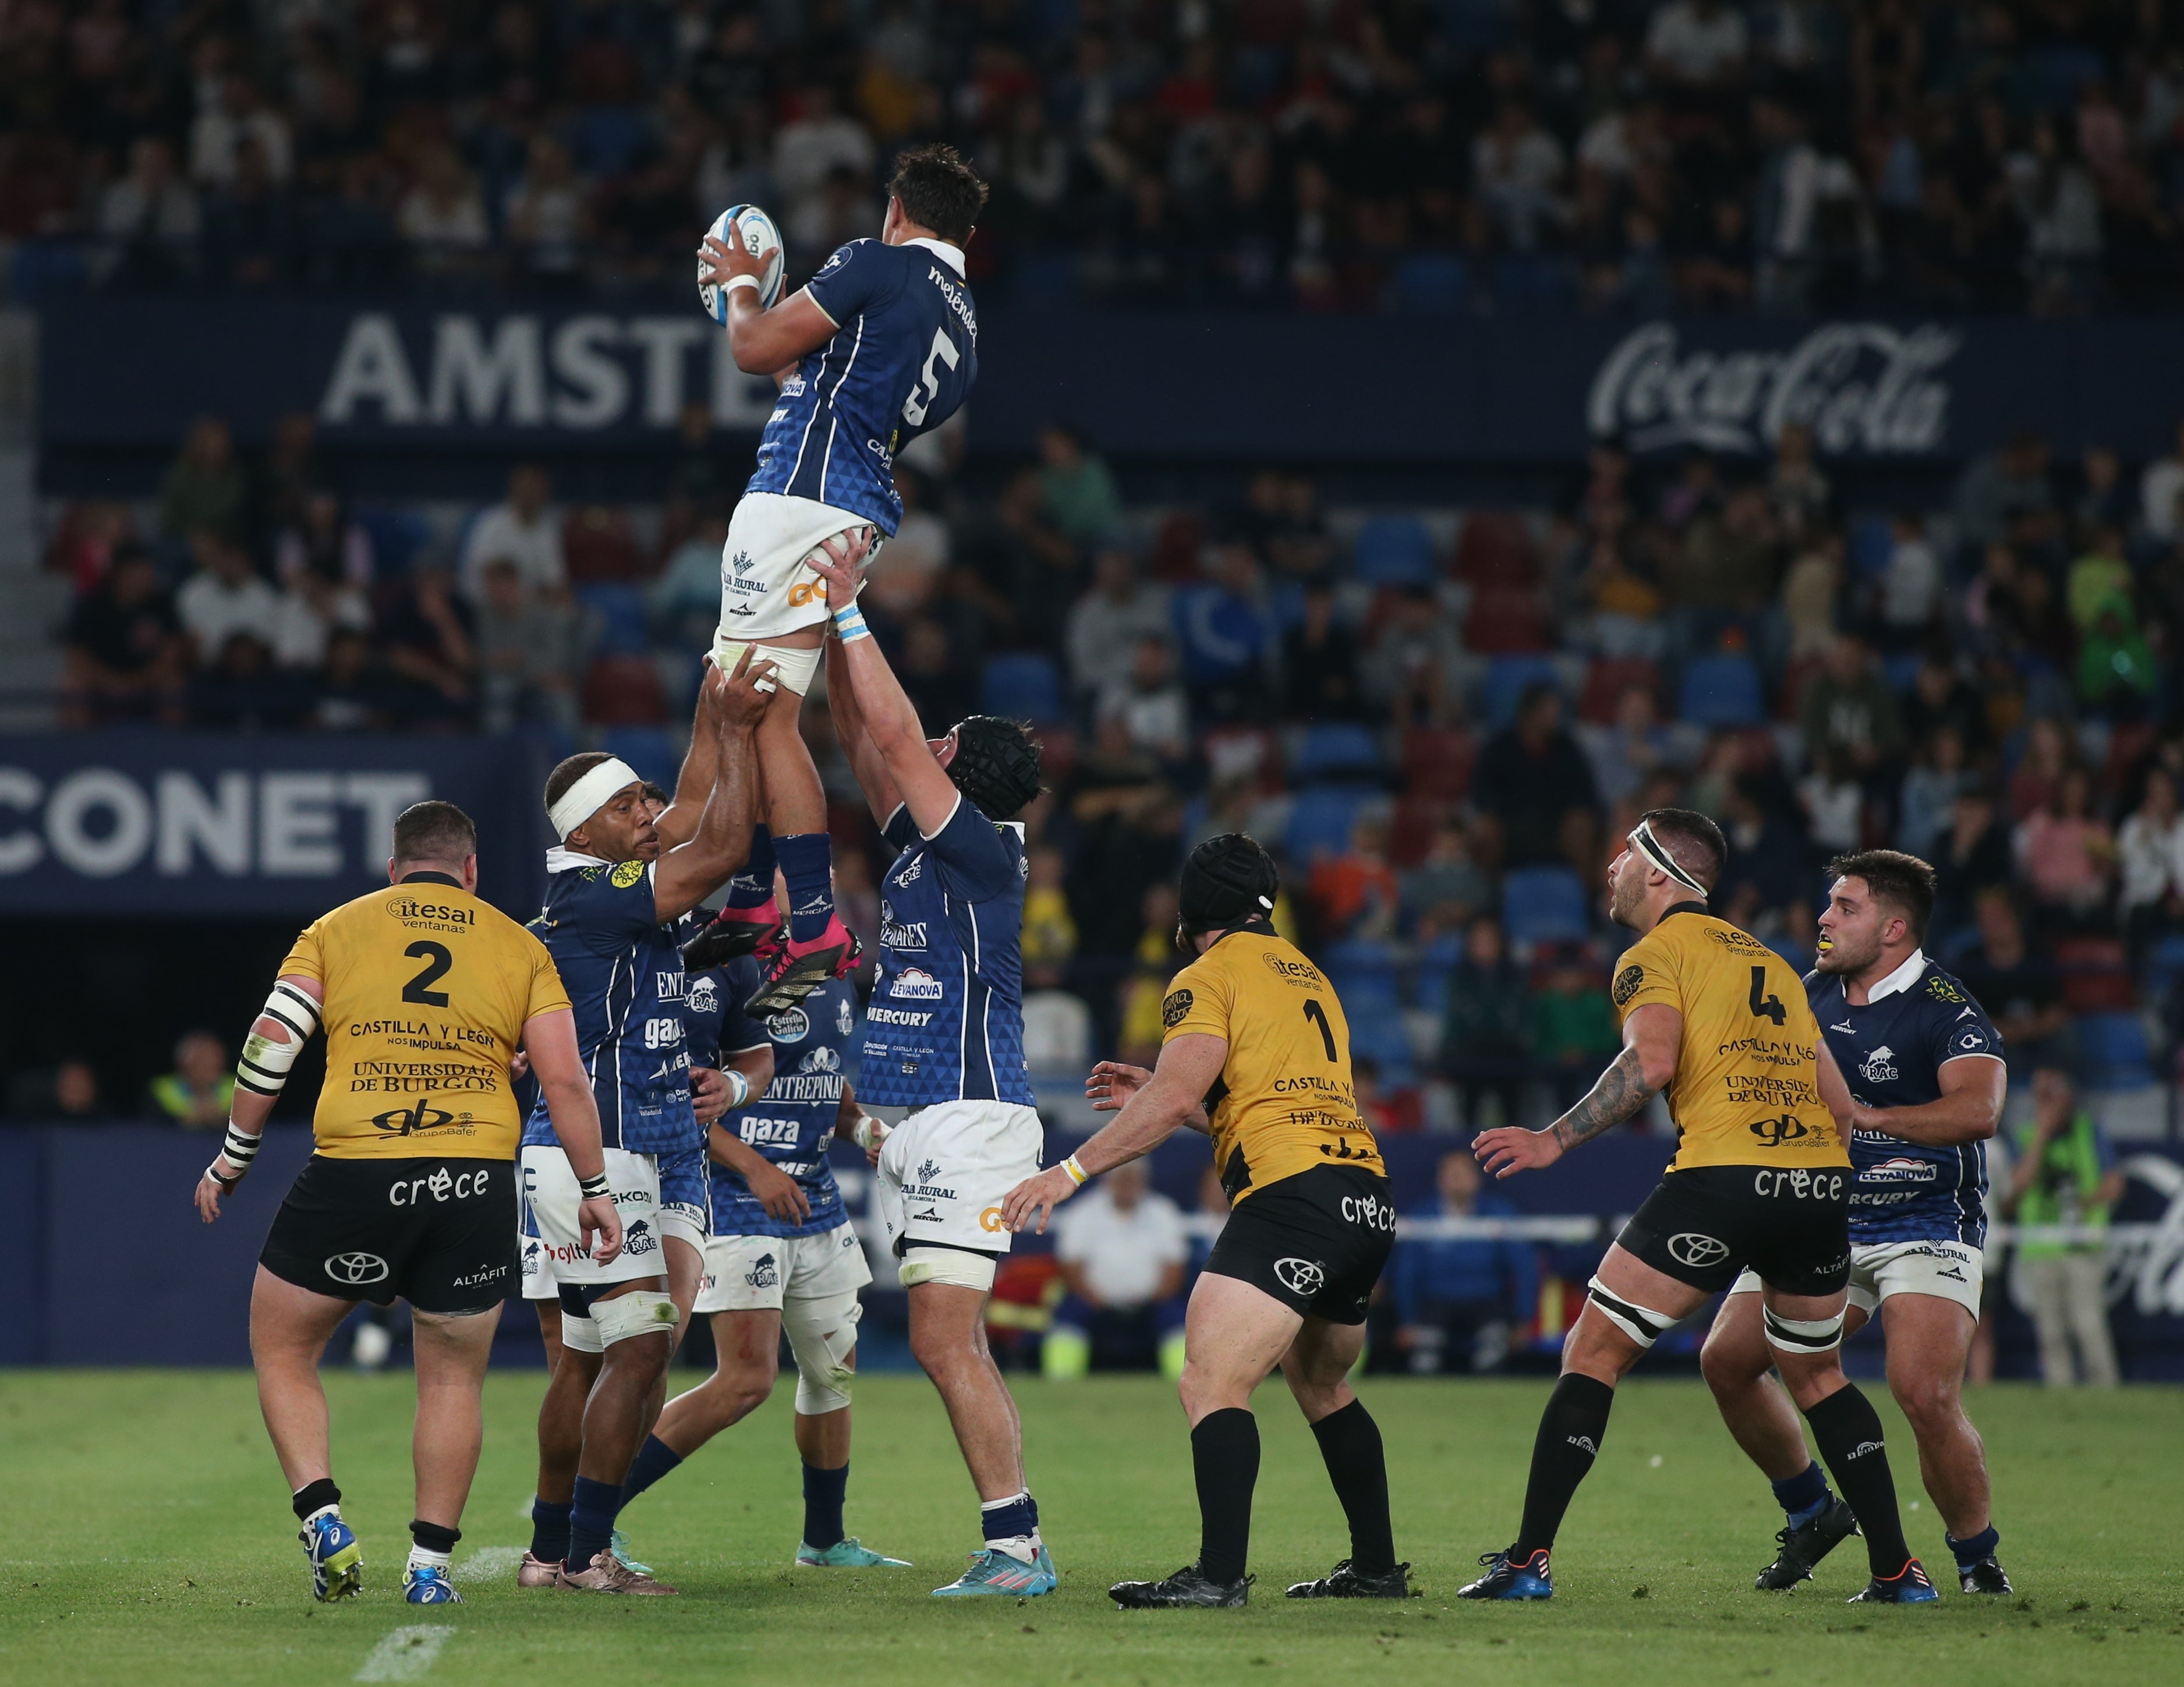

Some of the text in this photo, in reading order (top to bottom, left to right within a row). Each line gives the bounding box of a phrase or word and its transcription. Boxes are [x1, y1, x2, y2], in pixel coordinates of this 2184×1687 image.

[901, 326, 960, 426] 5
[730, 588, 751, 597] ZAMORA
[734, 578, 767, 593] RURAL
[729, 607, 758, 617] MERCURY
[401, 900, 476, 925] itesal
[402, 920, 465, 934] ventanas
[1726, 947, 1771, 957] ventanas
[402, 940, 452, 1008] 2
[892, 983, 941, 998] LEVANOVA
[1284, 977, 1322, 992] ventanas
[684, 993, 718, 1013] VRAC
[1748, 965, 1787, 1026] 4
[351, 1021, 494, 1048] CASTILLA Y LEÓN
[775, 1024, 804, 1035] Galicia
[1303, 999, 1337, 1063] 1
[1829, 1024, 1857, 1035] MERCURY
[409, 1039, 461, 1051] IMPULSA
[1783, 1041, 1791, 1056] Y
[1751, 1054, 1765, 1062] NOS
[1859, 1063, 1899, 1081] VRAC
[350, 1077, 497, 1092] DE BURGOS
[1274, 1077, 1339, 1092] CASTILLA
[1341, 1081, 1350, 1097] Y
[1728, 1090, 1751, 1102] DE
[739, 1116, 800, 1145] gaza
[1779, 1137, 1830, 1148] GrupoBafer
[390, 1166, 489, 1206] crece
[1754, 1169, 1842, 1201] crece
[918, 1186, 957, 1200] RURAL
[912, 1214, 944, 1223] MERCURY
[1936, 1270, 1968, 1283] MERCURY
